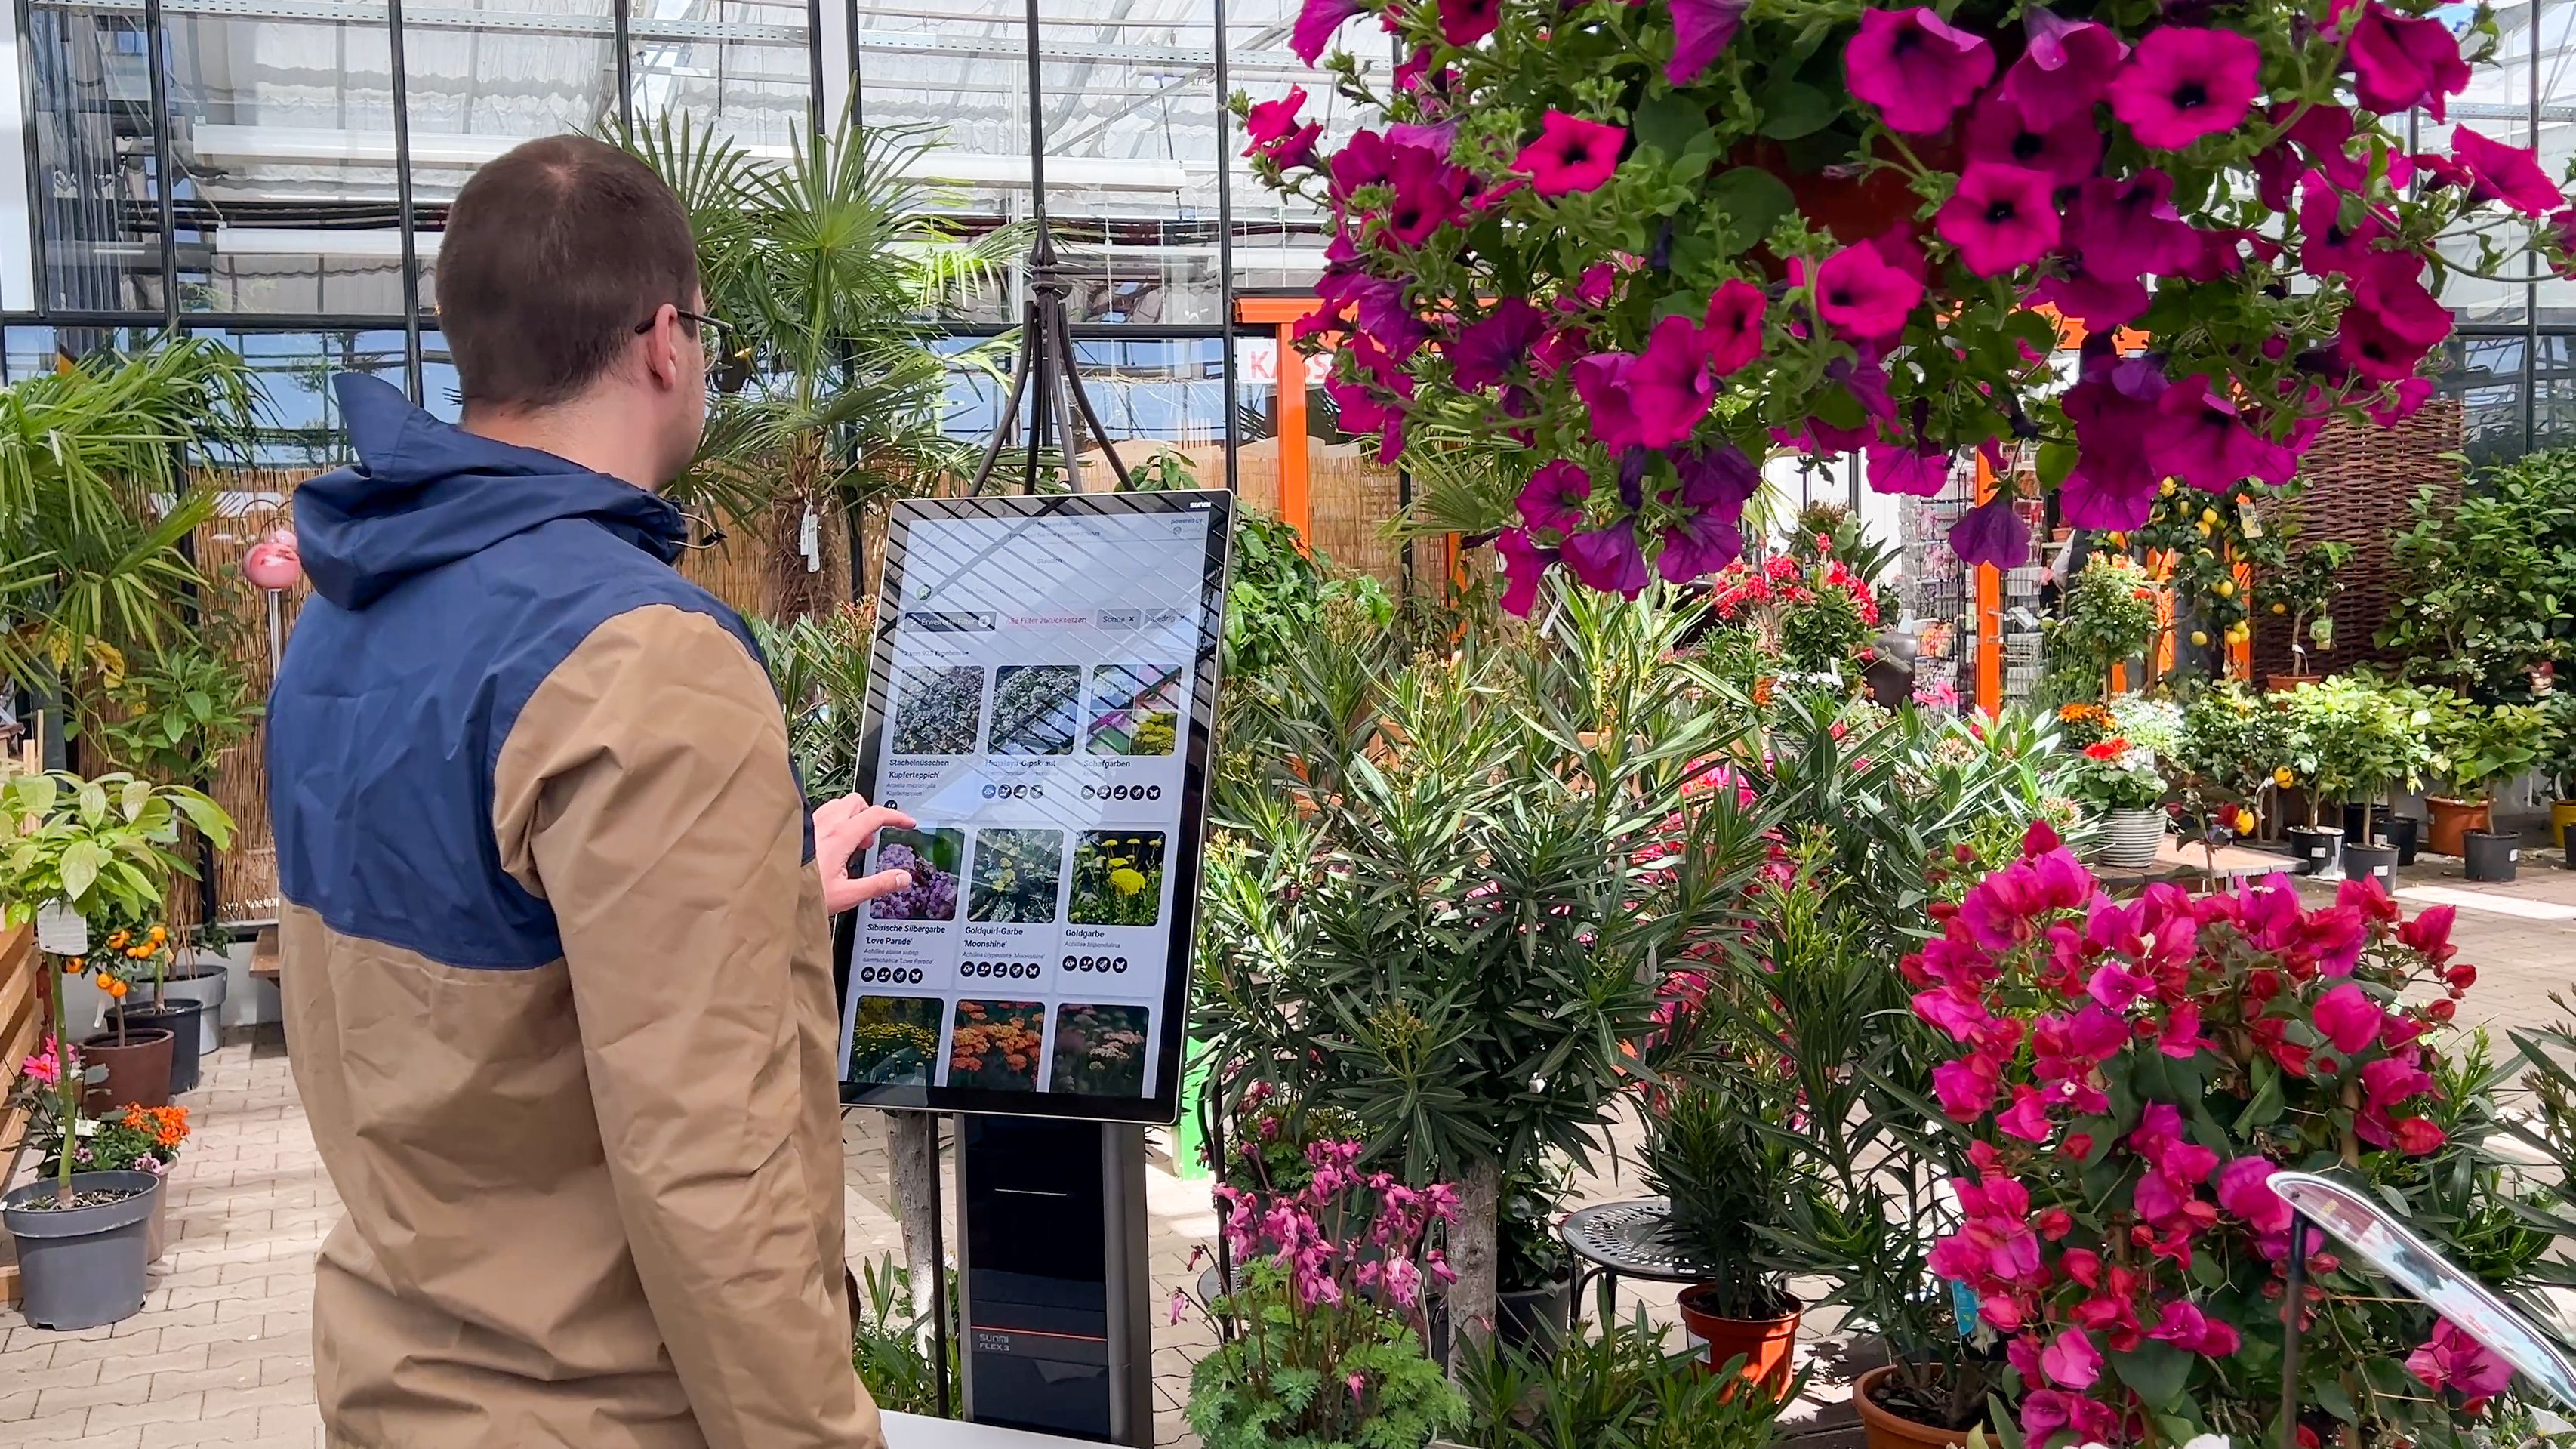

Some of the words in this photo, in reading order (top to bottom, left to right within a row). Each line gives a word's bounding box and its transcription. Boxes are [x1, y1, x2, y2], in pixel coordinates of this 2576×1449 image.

[1083, 759, 1131, 769] Schafgarben
[867, 923, 903, 932] Sibirische
[904, 925, 945, 934] Silbergarbe
[965, 926, 1024, 936] Goldquirl-Garbe
[1065, 929, 1105, 939] Goldgarbe
[886, 937, 913, 945] Parade'
[979, 1333, 1009, 1343] SUNMI
